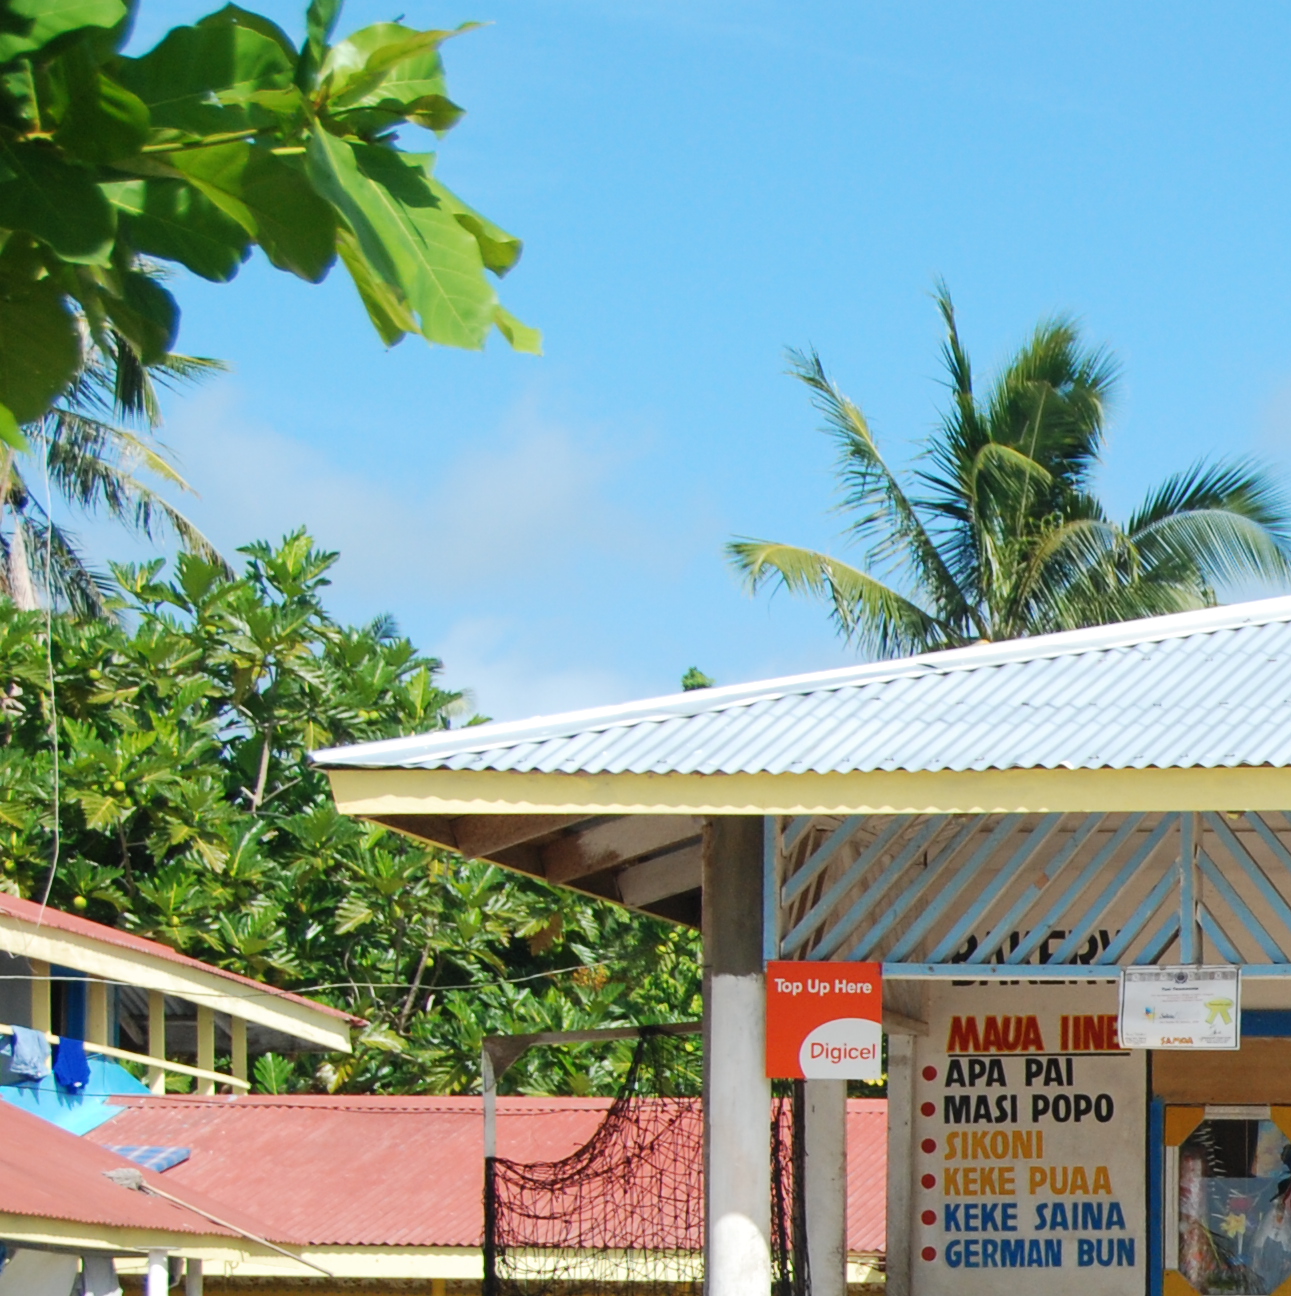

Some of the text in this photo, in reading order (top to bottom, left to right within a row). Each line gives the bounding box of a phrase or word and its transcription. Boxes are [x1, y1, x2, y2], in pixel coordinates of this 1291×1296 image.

[774, 977, 872, 996] Top Up Here
[946, 1013, 1132, 1052] MAUA IINE
[810, 1042, 876, 1065] Digicel
[945, 1058, 1075, 1088] APA PAI
[944, 1094, 1115, 1124] MASI POPO
[944, 1130, 1044, 1161] SIKONI
[944, 1166, 1113, 1196] KEKE PUAA
[944, 1201, 1127, 1233] KEKE SAINA
[945, 1238, 1136, 1269] GERMAN BUN
